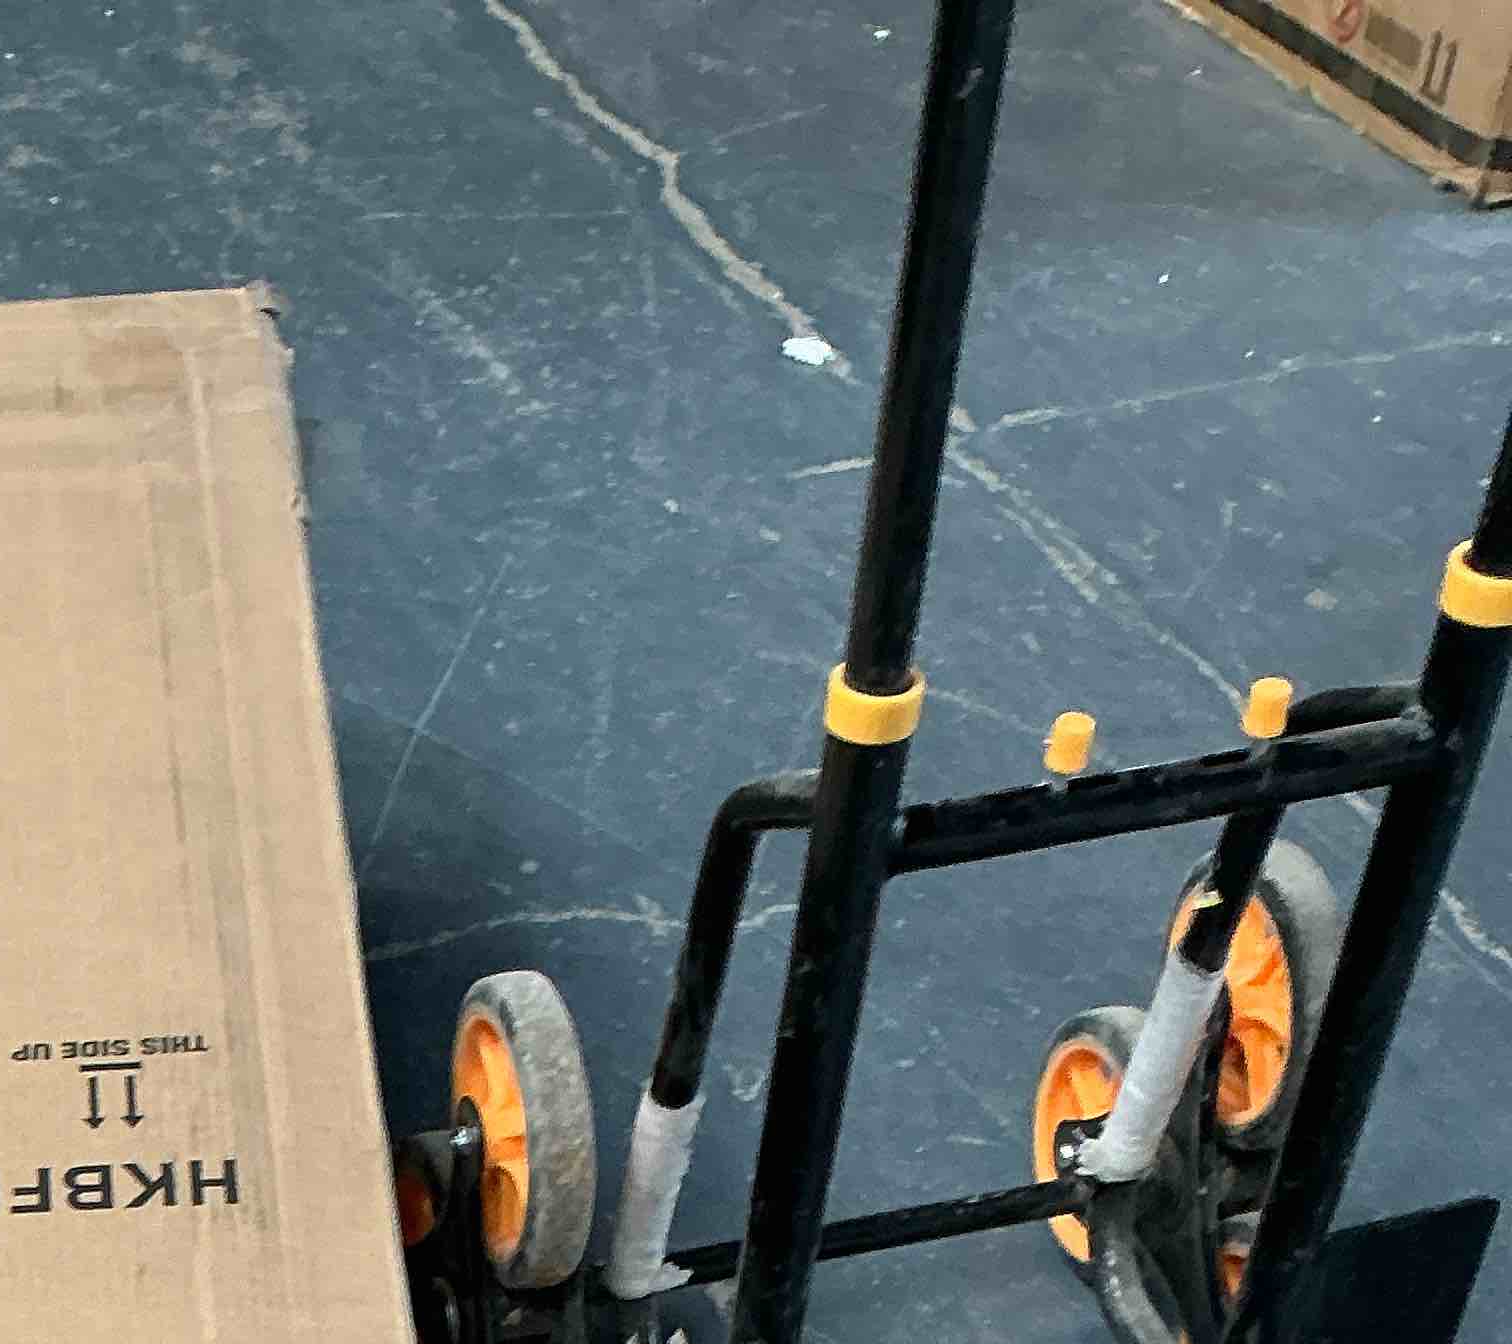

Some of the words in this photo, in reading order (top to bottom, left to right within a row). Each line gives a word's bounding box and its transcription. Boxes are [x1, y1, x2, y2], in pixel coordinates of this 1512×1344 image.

[10, 1041, 53, 1061] UP
[62, 1039, 130, 1059] SIDE
[140, 1034, 208, 1056] THIS
